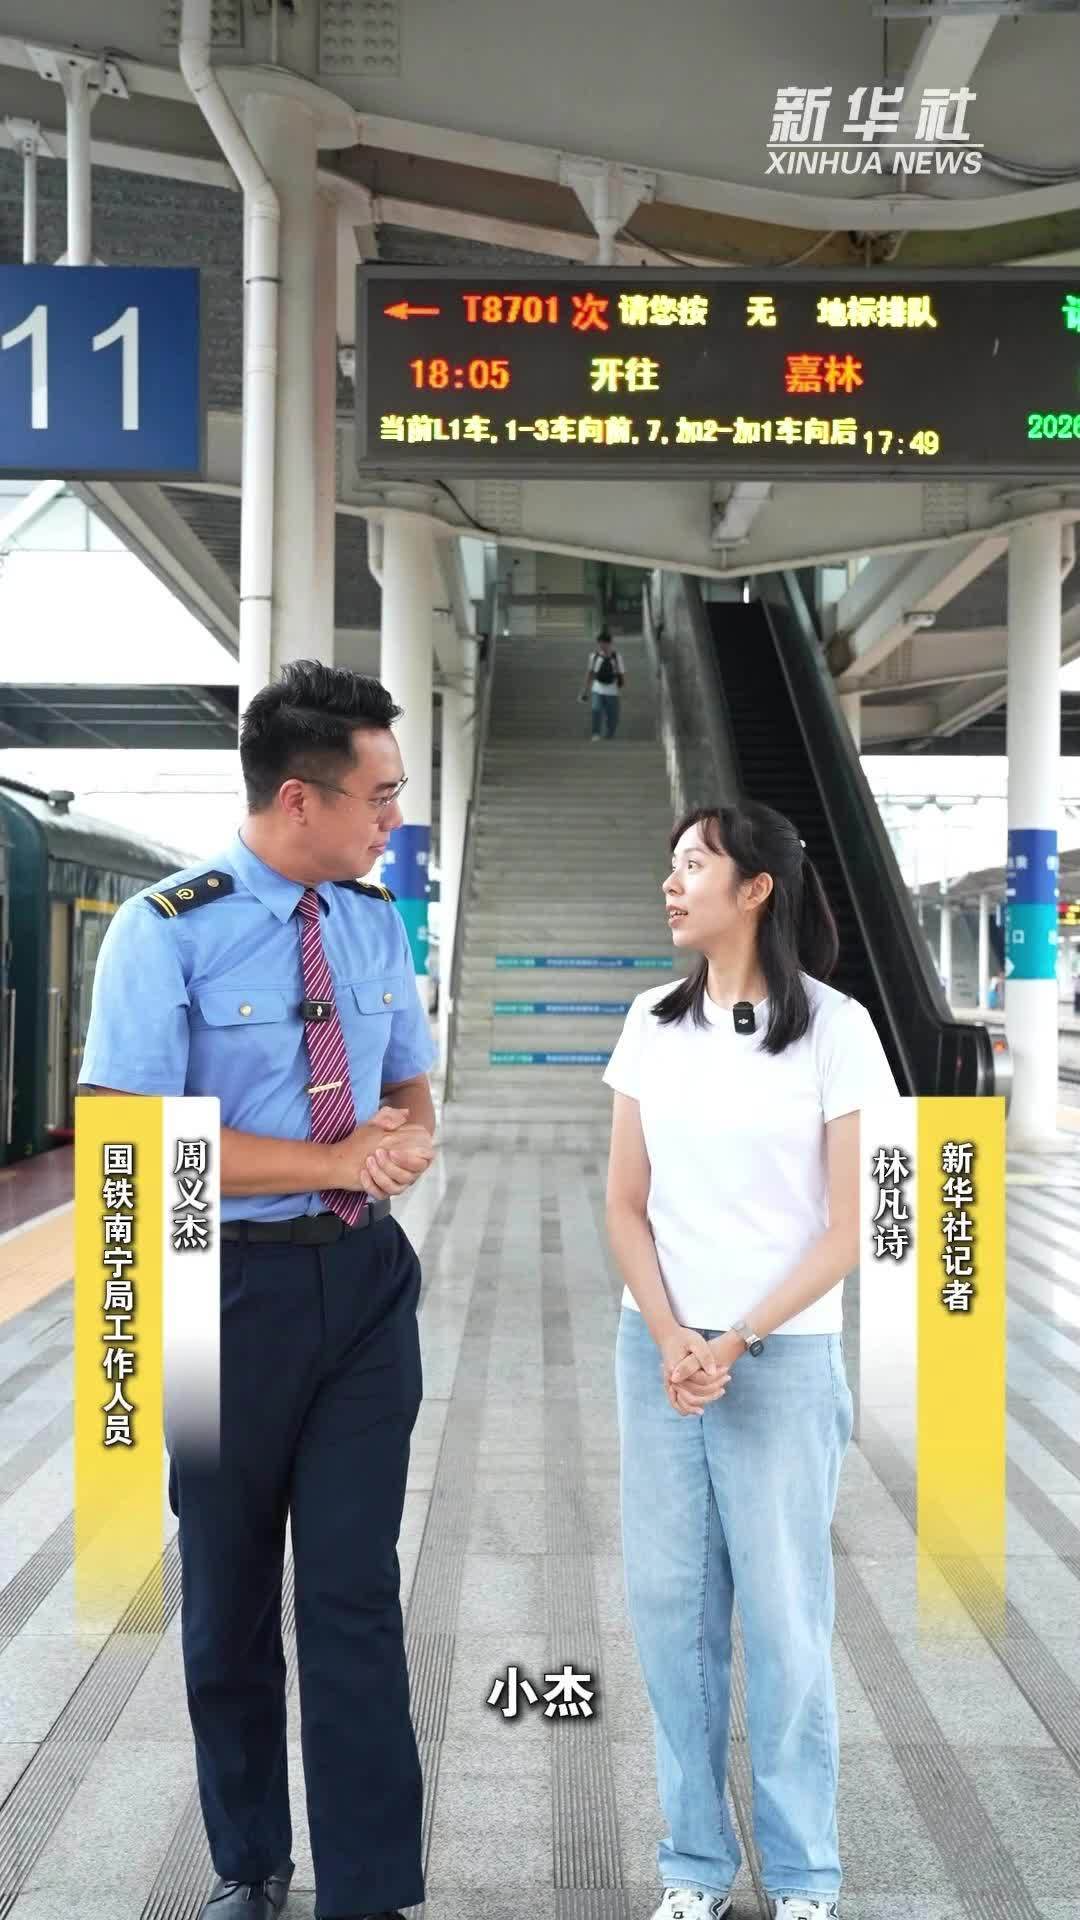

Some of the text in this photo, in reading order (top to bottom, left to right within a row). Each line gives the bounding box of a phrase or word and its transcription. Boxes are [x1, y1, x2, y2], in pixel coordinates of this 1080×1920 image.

[462, 293, 938, 331] T8701 次 请您按 无 地标排队
[1, 304, 139, 431] 11
[409, 354, 865, 393] 18:05 开往 嘉林
[863, 430, 940, 456] 17:49
